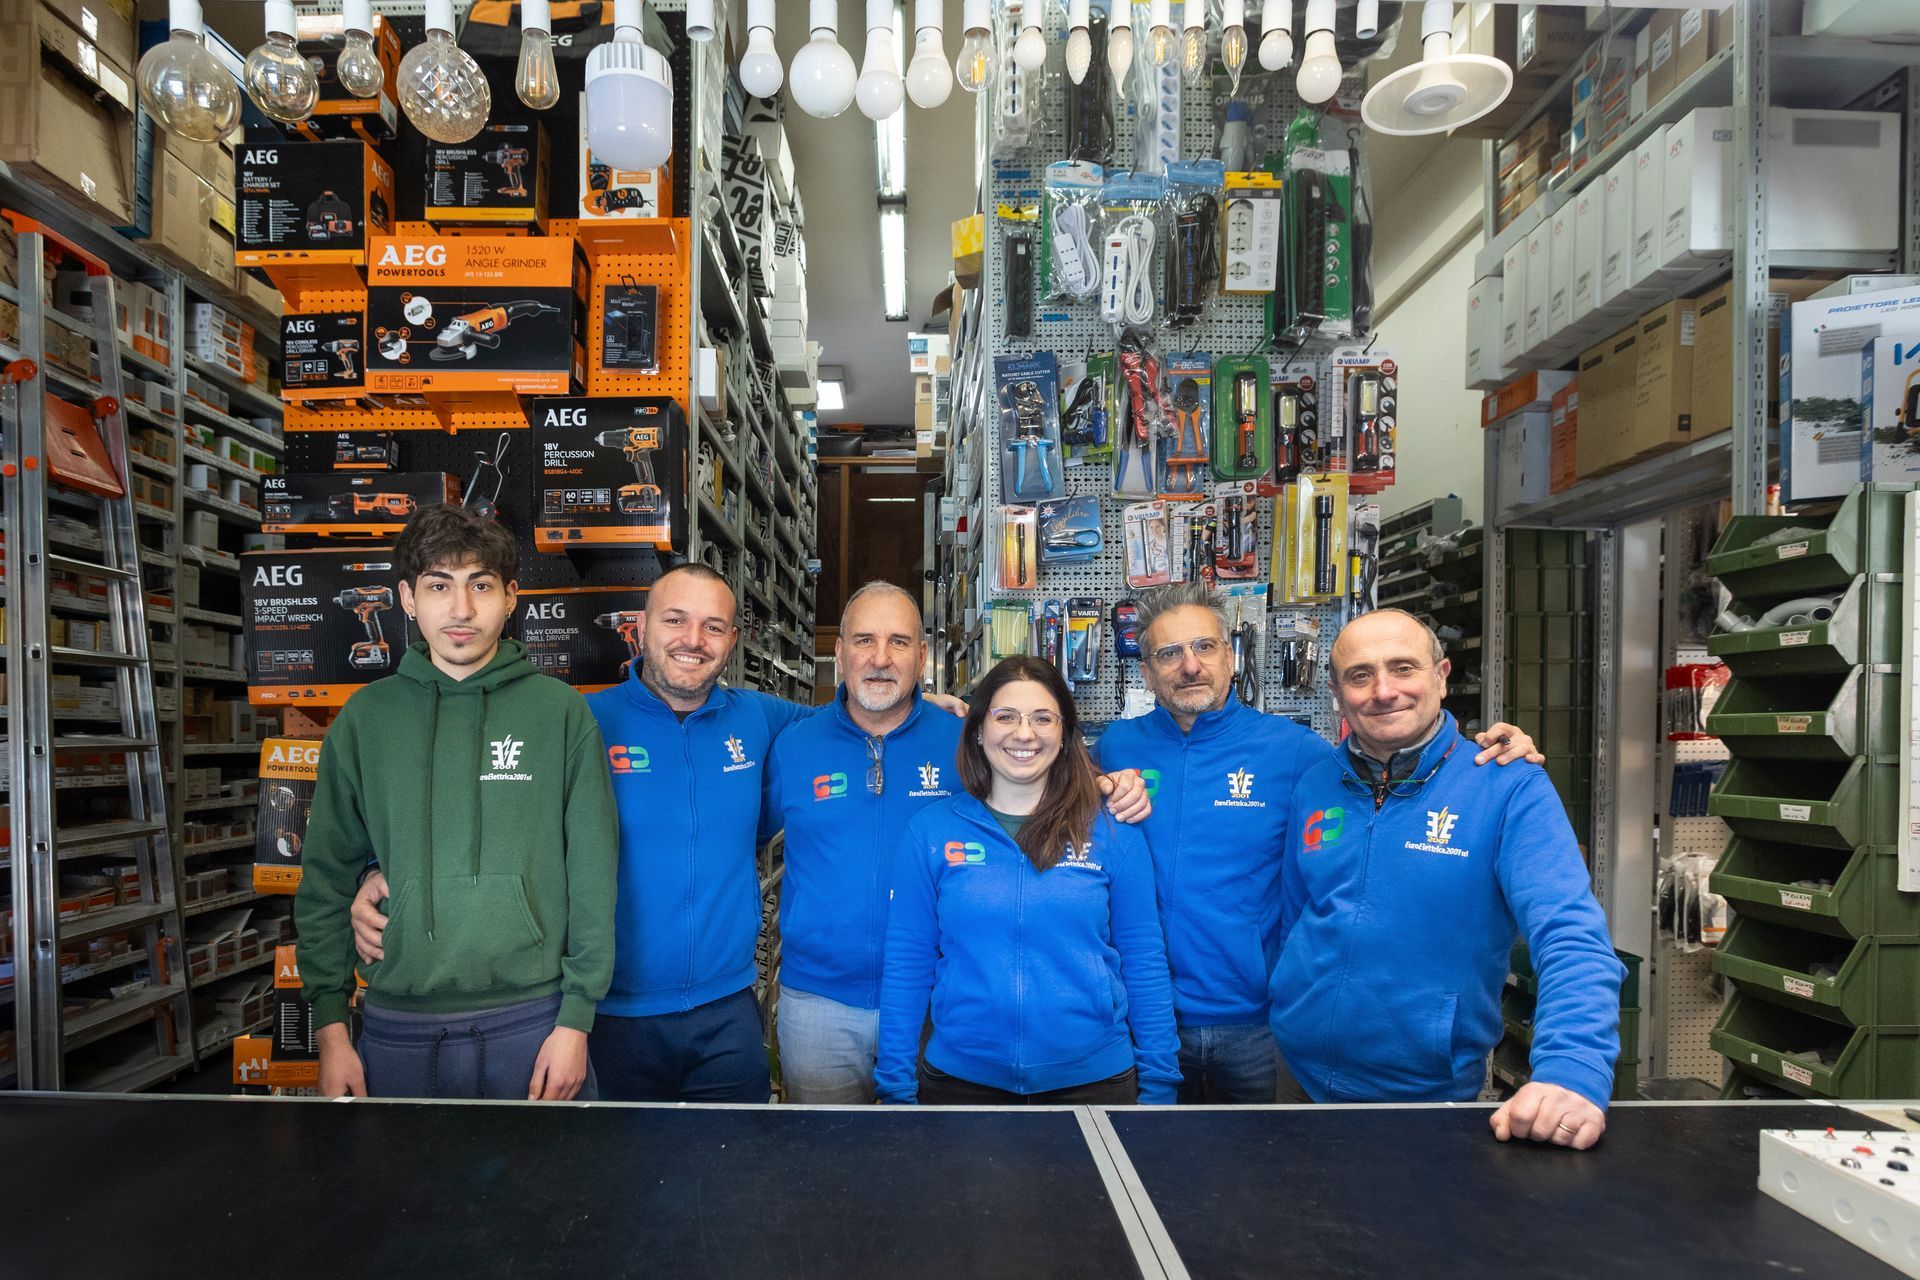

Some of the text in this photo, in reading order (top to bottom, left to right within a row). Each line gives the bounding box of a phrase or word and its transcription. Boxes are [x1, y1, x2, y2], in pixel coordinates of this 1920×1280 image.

[243, 150, 278, 165] AEG
[371, 160, 390, 187] AEG
[378, 244, 447, 267] AEG
[466, 245, 506, 255] 1520 W
[465, 258, 547, 268] ANGLE GRINDER
[377, 268, 446, 277] POWERTOOLS
[1827, 299, 1900, 314] PROIETTORE
[286, 320, 316, 334] AEG
[480, 318, 494, 332] AEG
[543, 408, 587, 427] AEG
[544, 450, 595, 459] PERCUSSION
[544, 459, 568, 467] DRILL
[264, 478, 286, 489] AEG
[1133, 511, 1160, 520] VELAMP
[252, 565, 303, 587] AEG
[254, 597, 318, 607] 18V BRUSHLESS
[254, 607, 288, 615] 3-SPEED
[525, 602, 566, 620] AEG
[254, 613, 323, 623] IMPACT WRENCH
[268, 745, 320, 765] AEG
